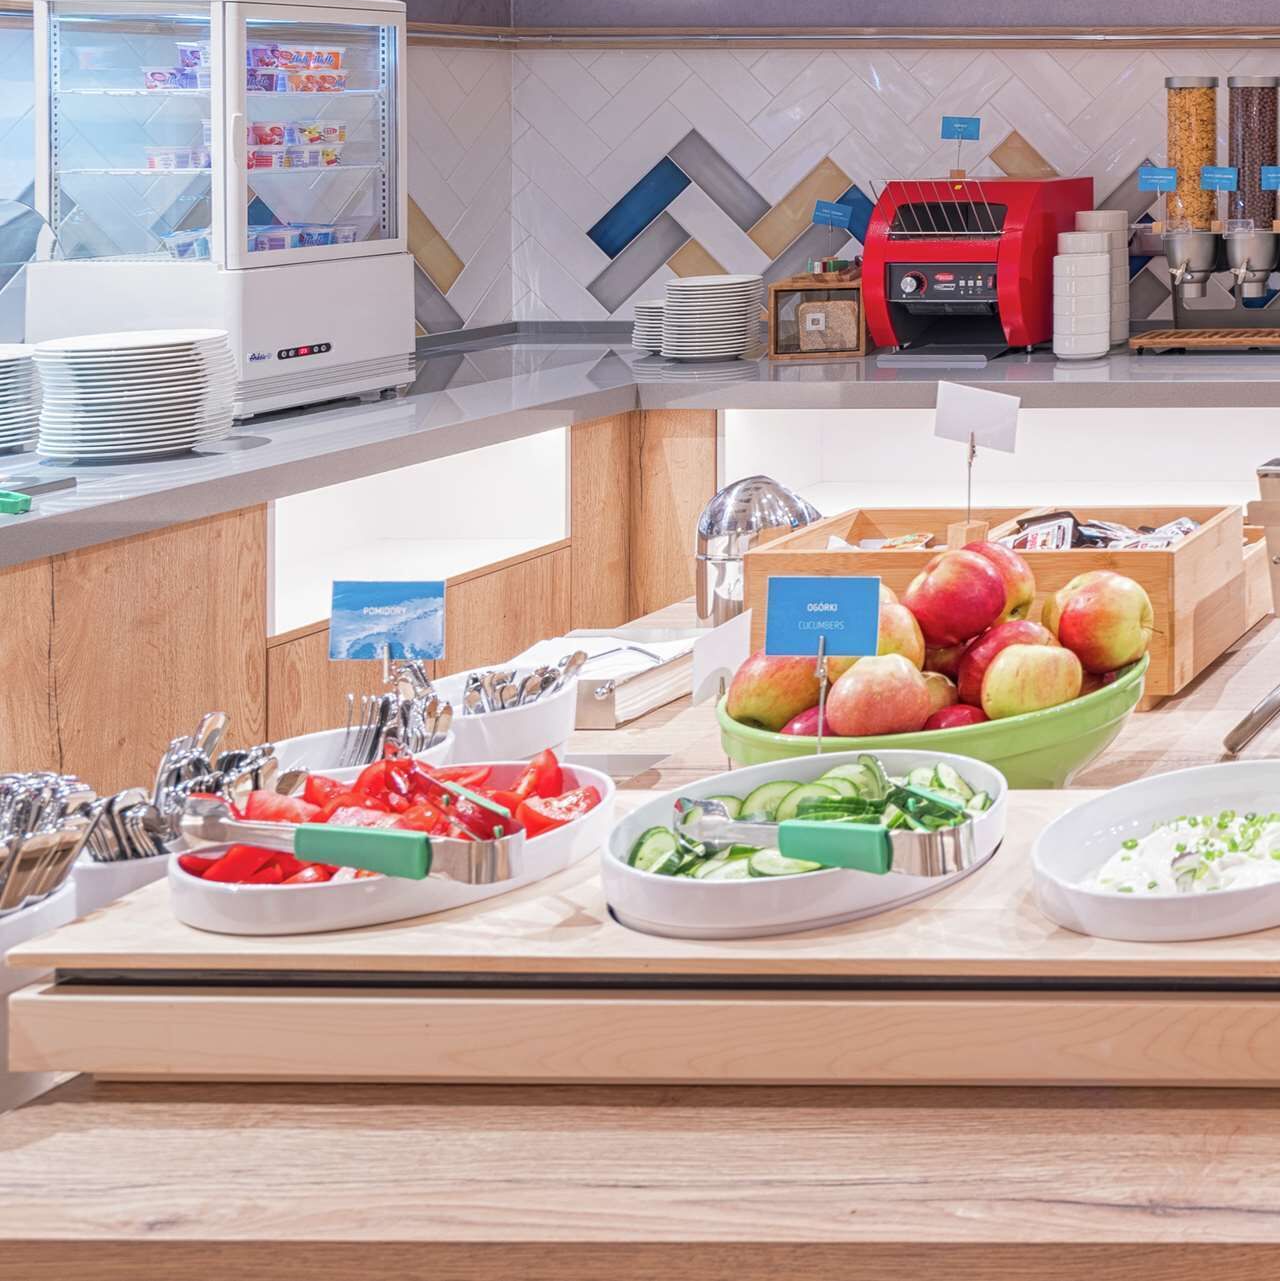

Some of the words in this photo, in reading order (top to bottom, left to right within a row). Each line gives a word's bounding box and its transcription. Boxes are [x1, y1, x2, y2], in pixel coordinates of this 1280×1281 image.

[363, 606, 408, 616] POMIDORY
[807, 602, 838, 612] OGÓRKI
[798, 620, 845, 631] CUCUMBERS
